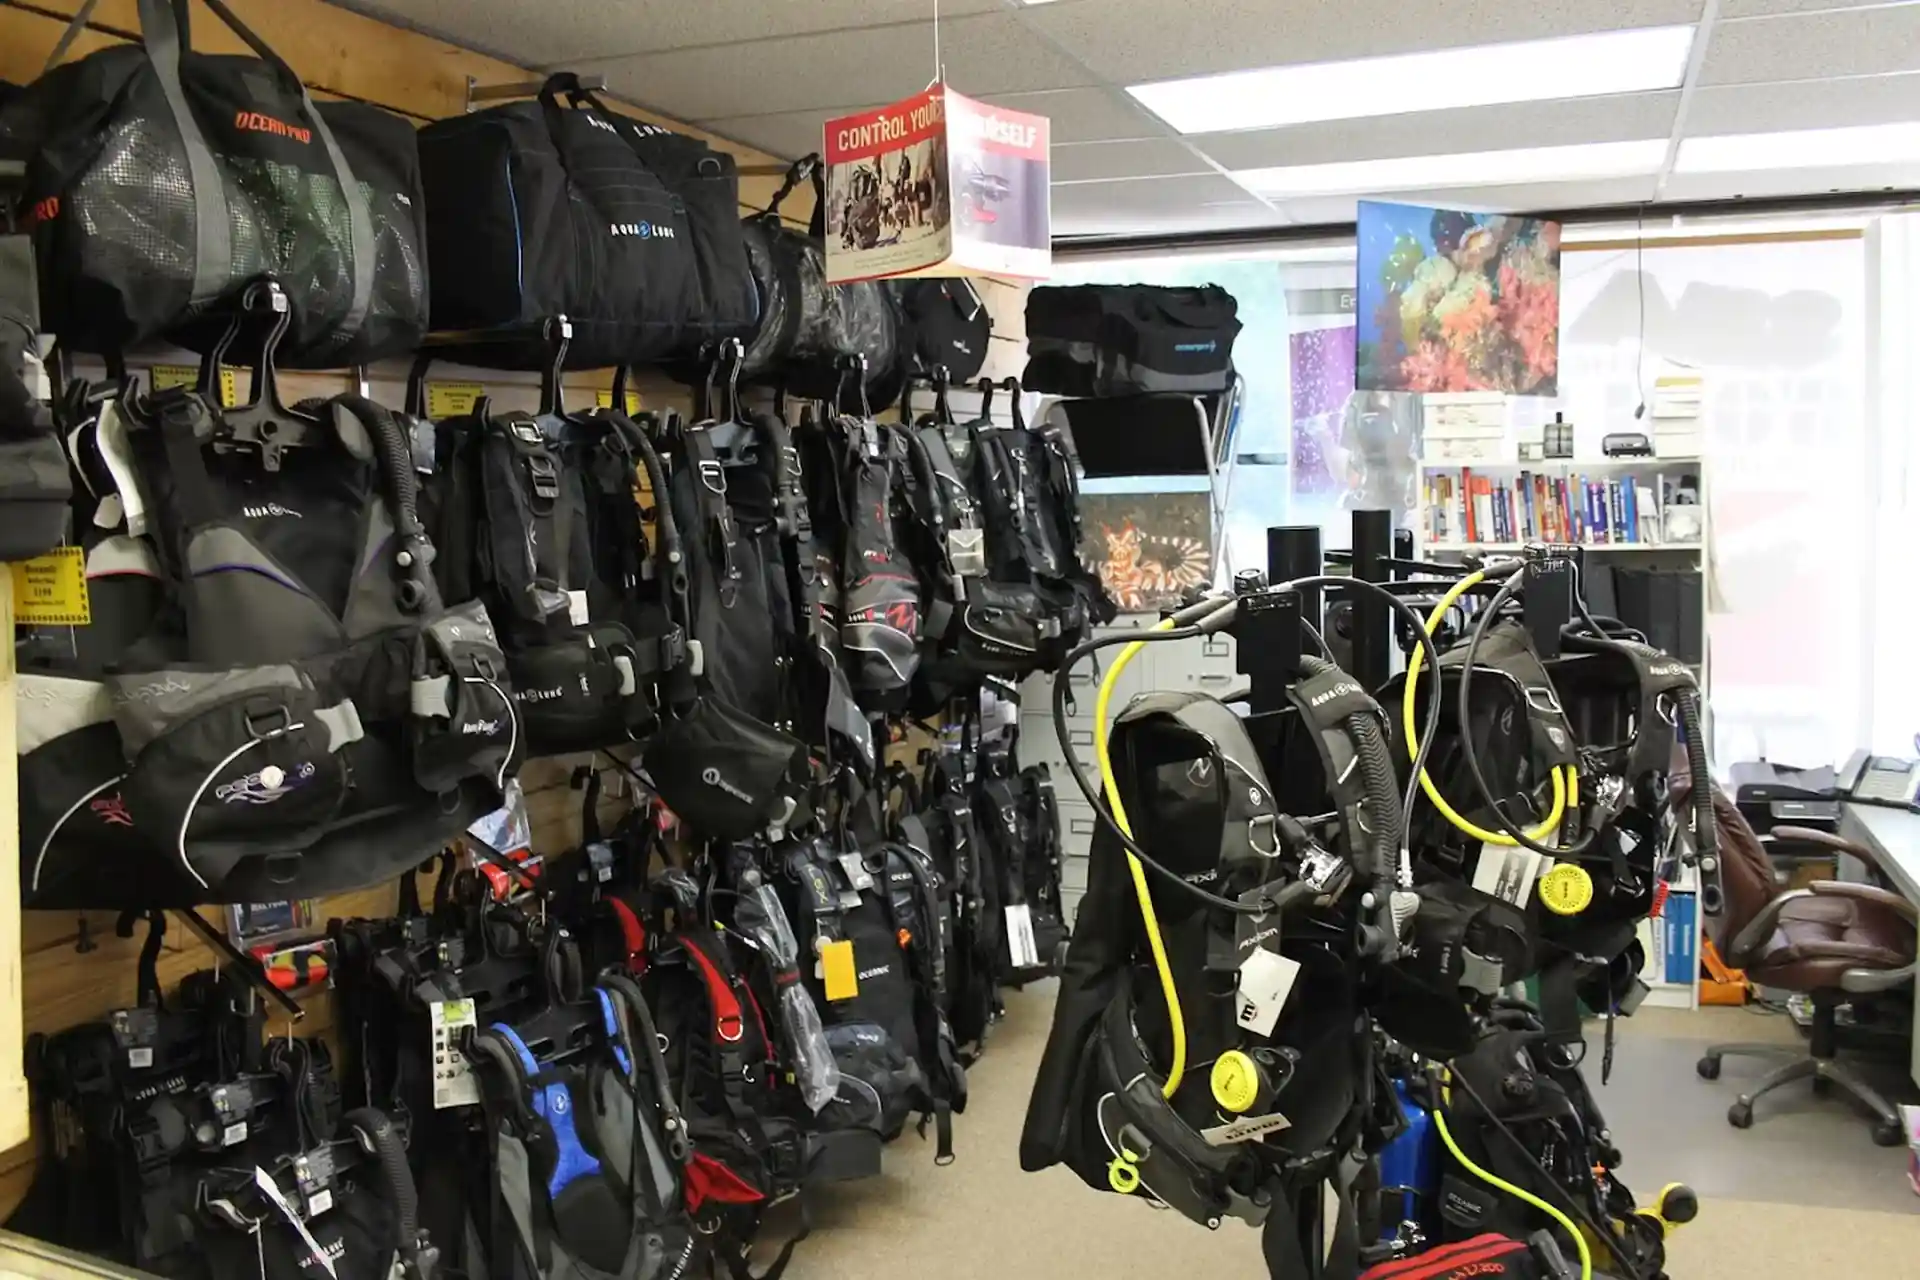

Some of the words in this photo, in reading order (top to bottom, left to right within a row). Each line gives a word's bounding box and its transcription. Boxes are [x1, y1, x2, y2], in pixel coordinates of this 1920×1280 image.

[838, 116, 908, 151] CONTROL
[243, 506, 270, 518] AQUA
[1311, 690, 1337, 707] AQUA
